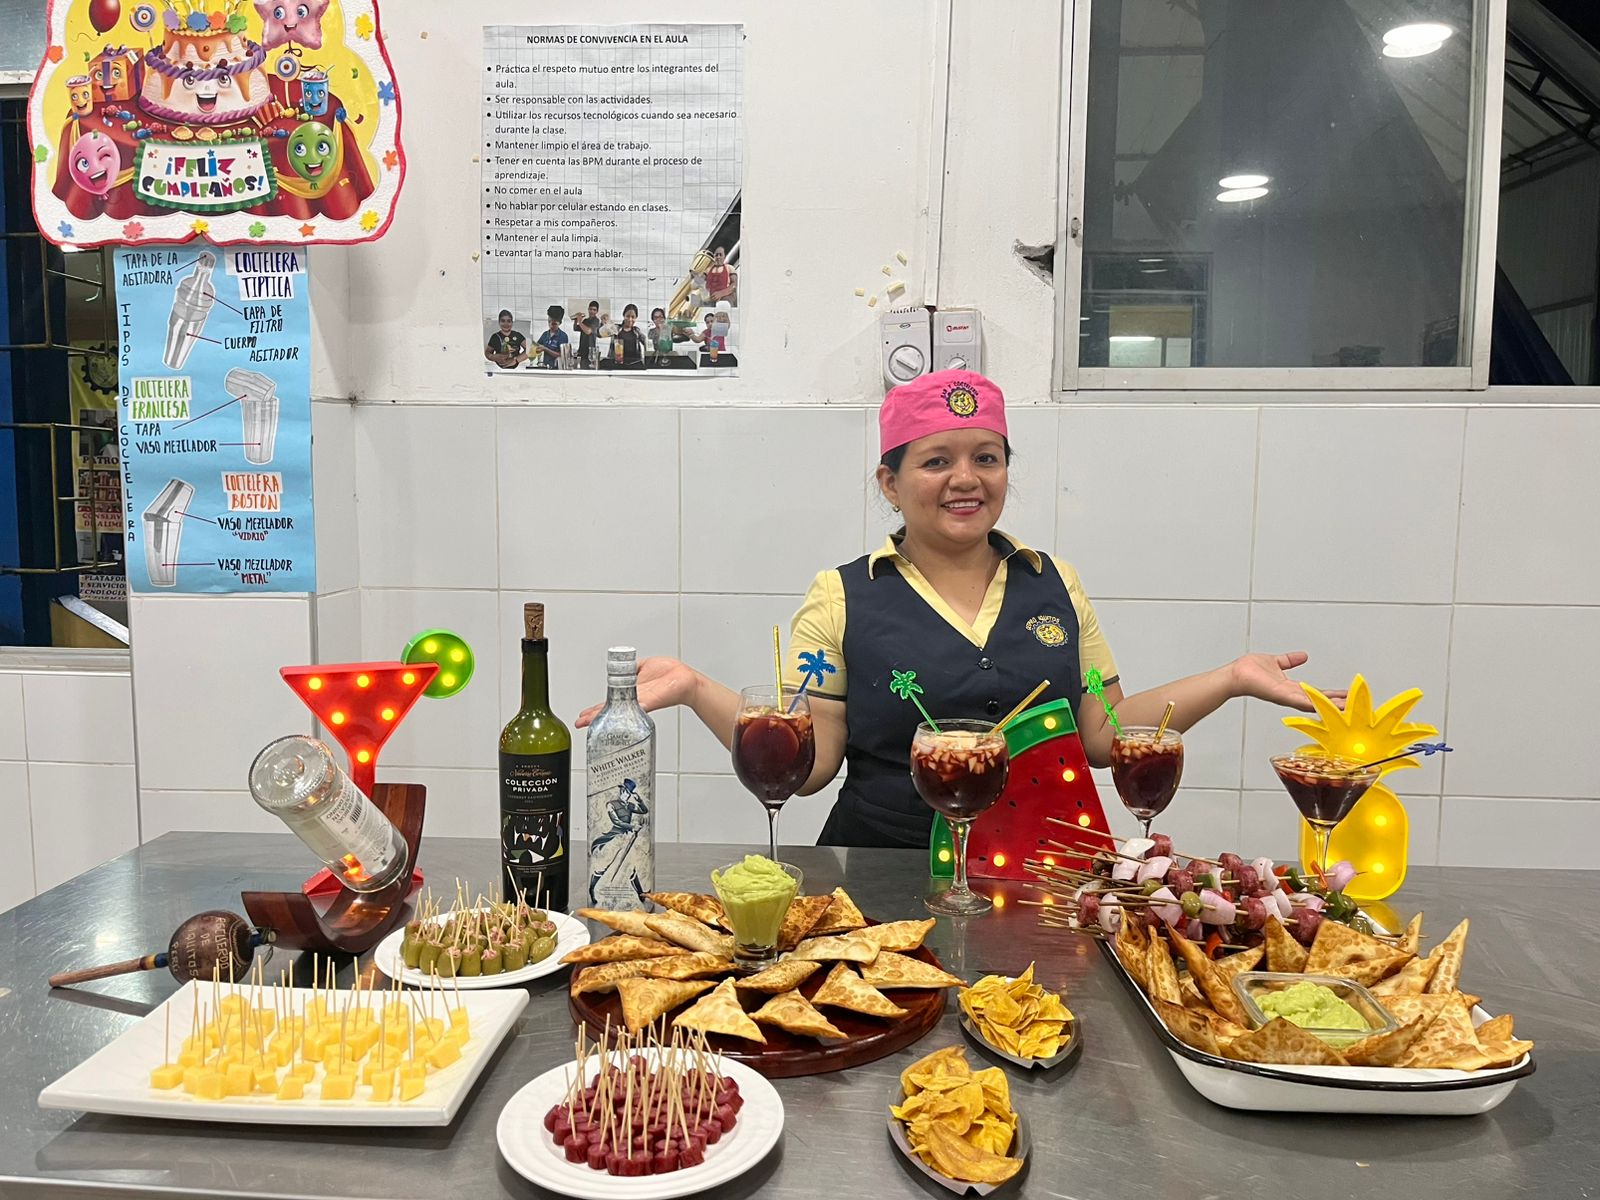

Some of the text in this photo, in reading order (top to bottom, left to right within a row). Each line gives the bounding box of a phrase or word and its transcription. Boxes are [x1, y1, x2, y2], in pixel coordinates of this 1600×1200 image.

[527, 35, 688, 44] NORMAS DE CONVIVENCIA EN EL AULA
[495, 64, 530, 73] Práctica
[532, 65, 540, 73] el
[542, 66, 576, 75] respeto
[611, 65, 634, 73] entre
[637, 64, 649, 73] los
[652, 64, 702, 75] integrantes
[705, 63, 719, 73] del
[495, 80, 516, 89] aula.
[495, 95, 510, 104] Ser
[512, 95, 565, 106] responsable
[586, 95, 598, 104] las
[600, 95, 653, 104] actividades.
[495, 111, 526, 119] Utilizar
[529, 111, 541, 119] los
[583, 110, 638, 121] tecnológicos
[641, 111, 674, 119] cuando
[694, 111, 736, 119] necesario
[495, 126, 567, 134] durante la clase.
[495, 141, 651, 152] Mantener limpio el área de trabajo.
[165, 156, 236, 177] ¡FELIZ
[495, 157, 519, 165] Tener
[568, 157, 580, 165] las
[582, 157, 603, 165] BPM
[605, 157, 640, 165] durante
[643, 157, 651, 165] el
[653, 158, 688, 167] proceso
[691, 156, 702, 165] de
[494, 171, 548, 182] aprendizaje.
[142, 175, 264, 198] CUMPLEAÑOS!
[494, 186, 507, 194] No
[554, 186, 561, 195] el
[563, 186, 582, 195] aula
[494, 202, 507, 210] No
[510, 202, 538, 211] hablar
[541, 204, 555, 213] por
[558, 202, 587, 211] celular
[590, 202, 625, 211] estando
[642, 203, 671, 211] clases.
[494, 218, 533, 228] Respetar
[543, 218, 559, 227] mis
[561, 218, 618, 229] compañeros.
[494, 234, 601, 244] Mantener el aula limpia.
[123, 252, 178, 270] TAPA DE LA
[494, 249, 532, 257] Levantar
[535, 249, 542, 257] la
[572, 251, 592, 260] para
[594, 249, 624, 258] hablar.
[235, 251, 299, 274] COCTELERA
[123, 271, 173, 286] AGITADORA
[271, 305, 282, 317] DE
[250, 319, 283, 334] FILTRO
[224, 336, 257, 349] CUERPO
[249, 347, 299, 362] AGITADOR
[135, 379, 189, 399] COCTELERA
[133, 400, 189, 419] FRANCESA
[135, 423, 161, 436] TAPA
[136, 440, 217, 454] VASO MEZCLADOR
[225, 474, 279, 492] COCTELERA
[231, 494, 278, 510] BOSTON
[217, 517, 294, 530] VASO MEZCLADOR
[218, 558, 292, 571] VASO MEZCLADOR
[591, 749, 646, 773] WHITE WALKER
[505, 778, 558, 786] COLECCIÓN
[200, 933, 210, 947] DE
